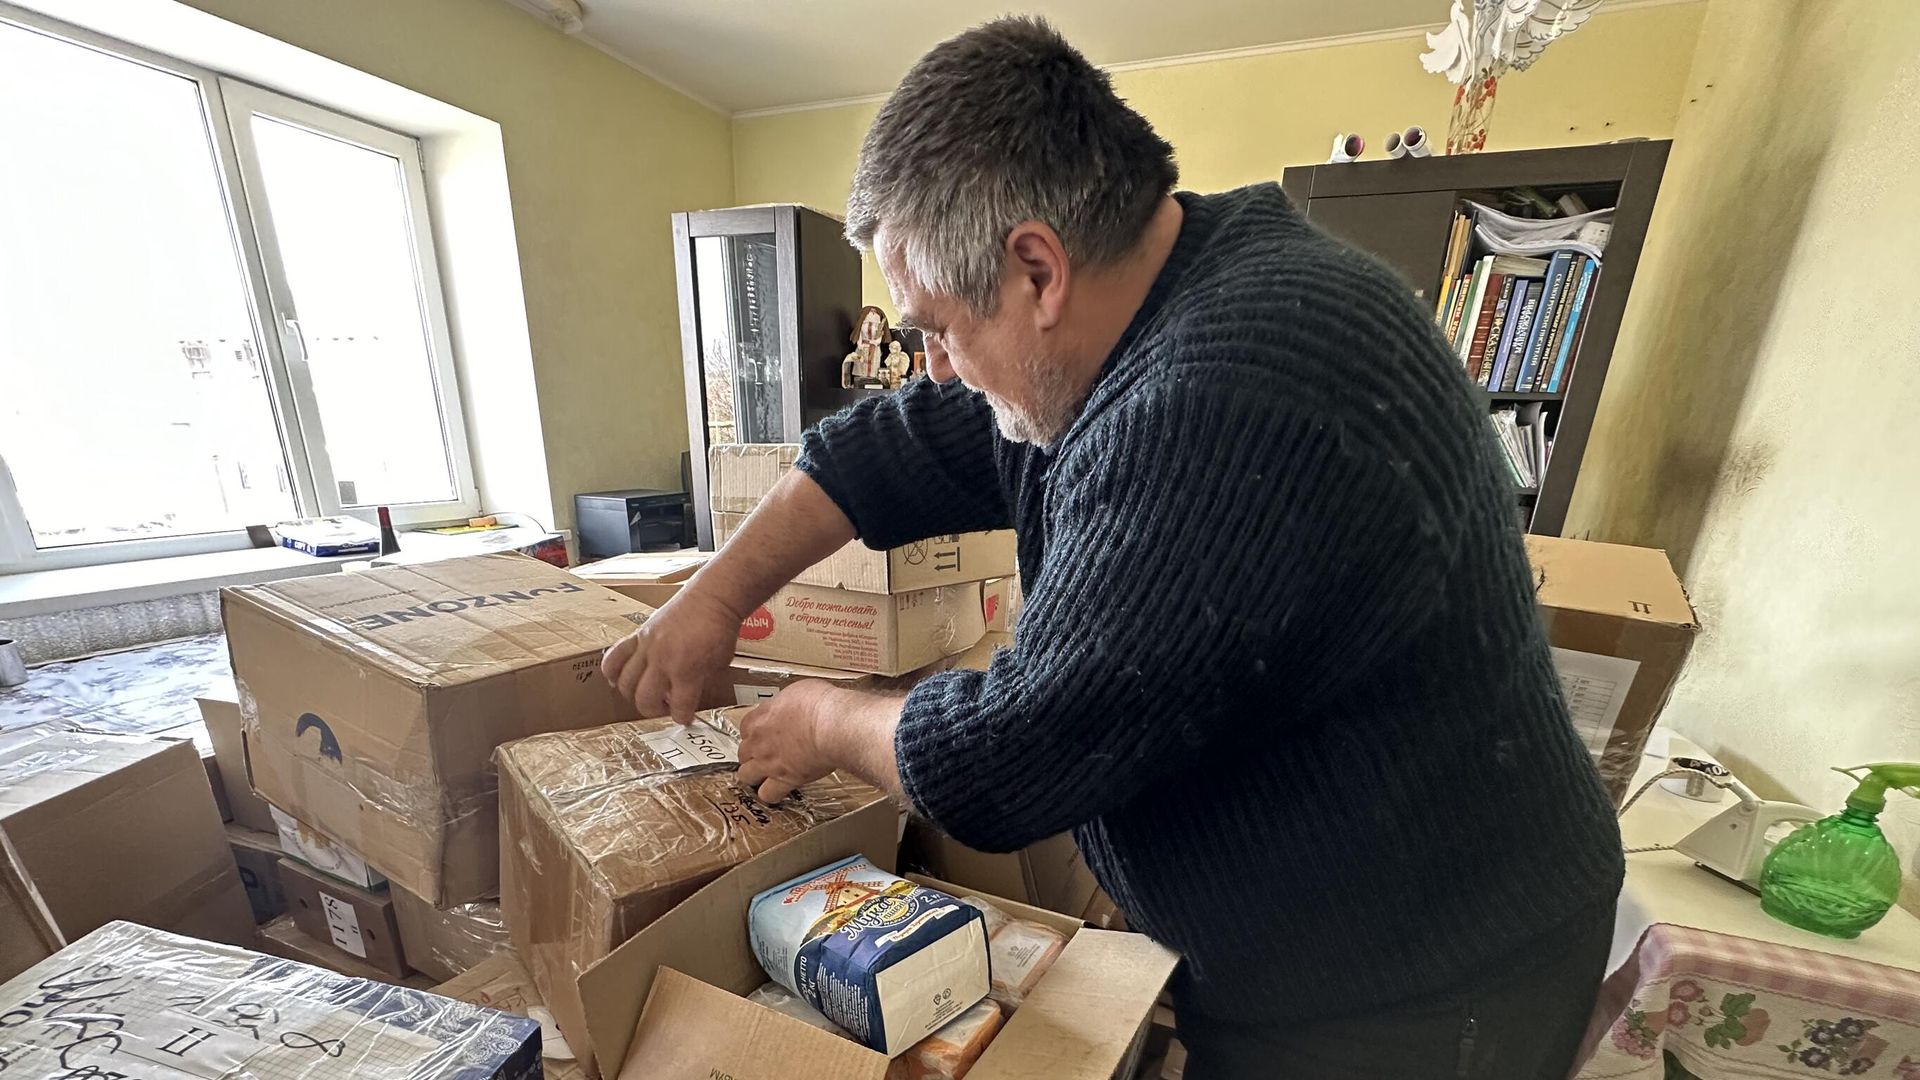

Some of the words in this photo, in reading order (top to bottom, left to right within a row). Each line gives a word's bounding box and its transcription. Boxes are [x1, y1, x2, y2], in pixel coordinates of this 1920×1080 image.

[356, 581, 585, 631] FUNZONE
[785, 596, 815, 611] Добро
[815, 602, 878, 617] пожаловать
[796, 612, 831, 628] страну
[831, 617, 875, 631] печенья!
[688, 732, 726, 760] 4560
[840, 894, 896, 940] Мука
[799, 956, 808, 981] НЕТТО
[807, 988, 816, 997] 2
